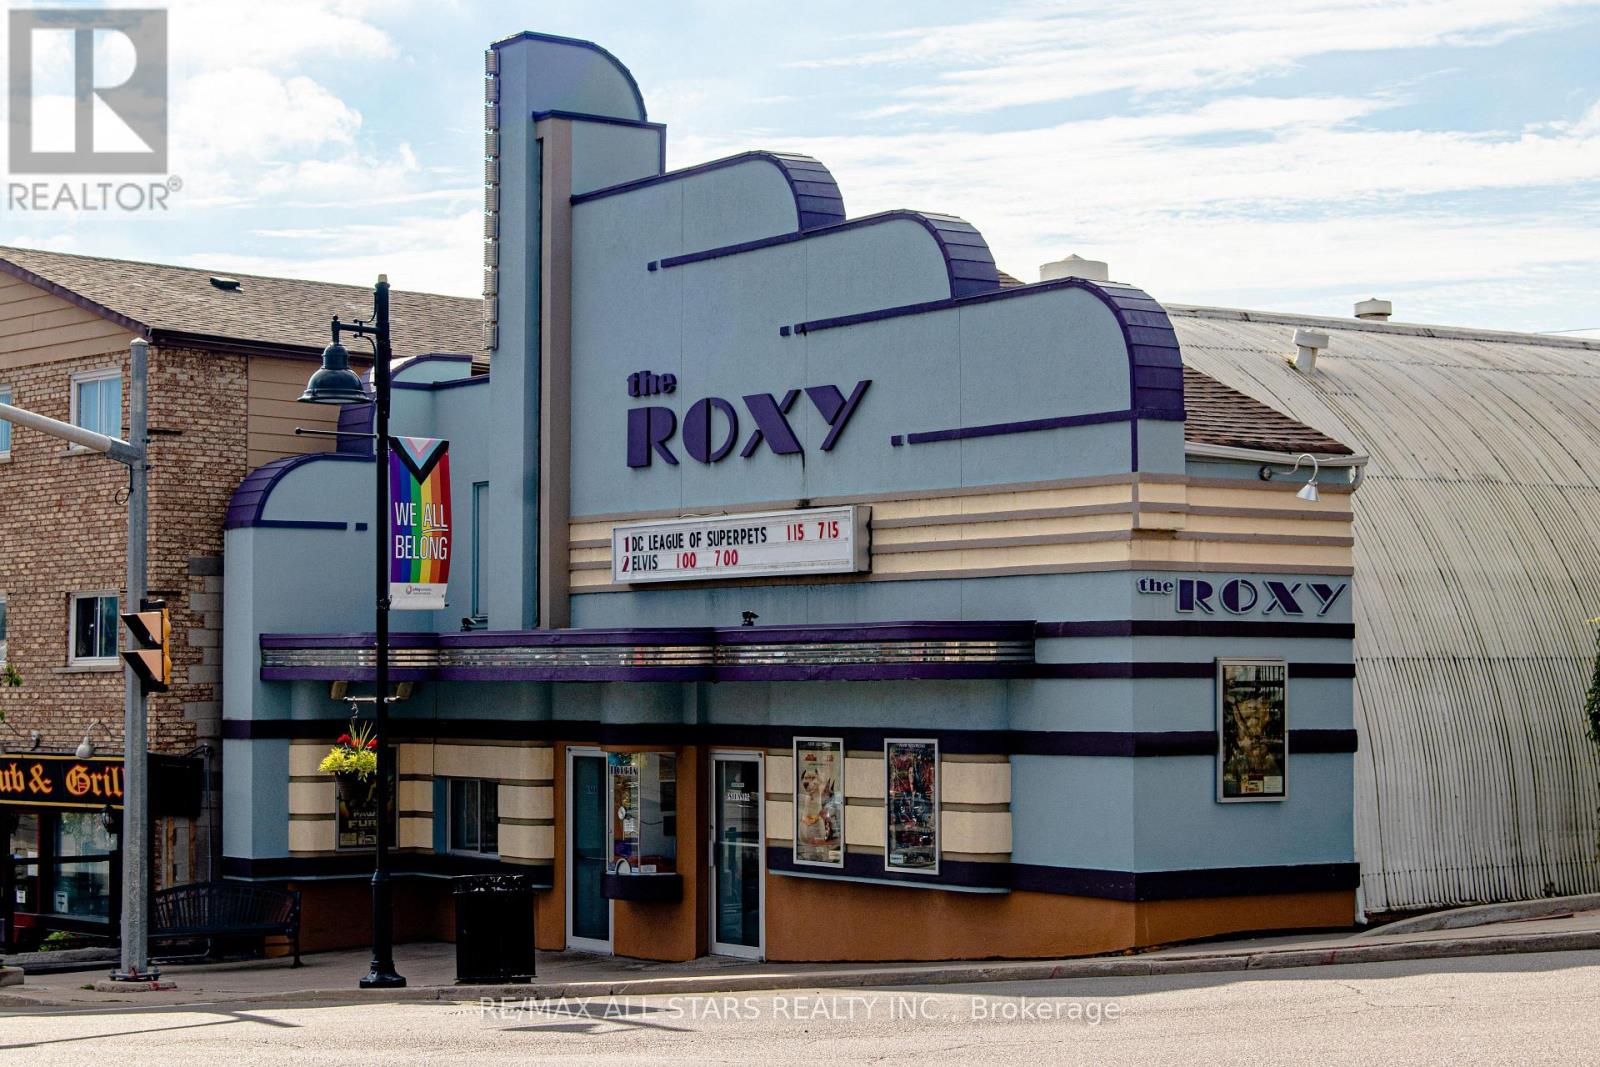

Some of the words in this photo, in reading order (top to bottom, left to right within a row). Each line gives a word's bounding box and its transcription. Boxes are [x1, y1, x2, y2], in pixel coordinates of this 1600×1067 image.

[626, 370, 678, 398] the
[626, 379, 873, 468] ROXY
[394, 502, 416, 526] WE
[423, 503, 448, 528] ALL
[395, 535, 448, 560] BELONG
[632, 536, 644, 552] DC
[649, 532, 684, 550] LEAGUE
[689, 531, 702, 548] OF
[707, 526, 767, 547] SUPERPETS
[787, 523, 804, 541] 115
[818, 521, 839, 539] 715
[632, 554, 658, 571] ELVIS
[676, 552, 696, 569] 100
[715, 550, 738, 566] 700
[1136, 576, 1174, 595] the
[1176, 577, 1347, 616] ROXY
[0, 762, 25, 793] ub
[28, 763, 53, 794] &
[65, 764, 125, 797] Gril
